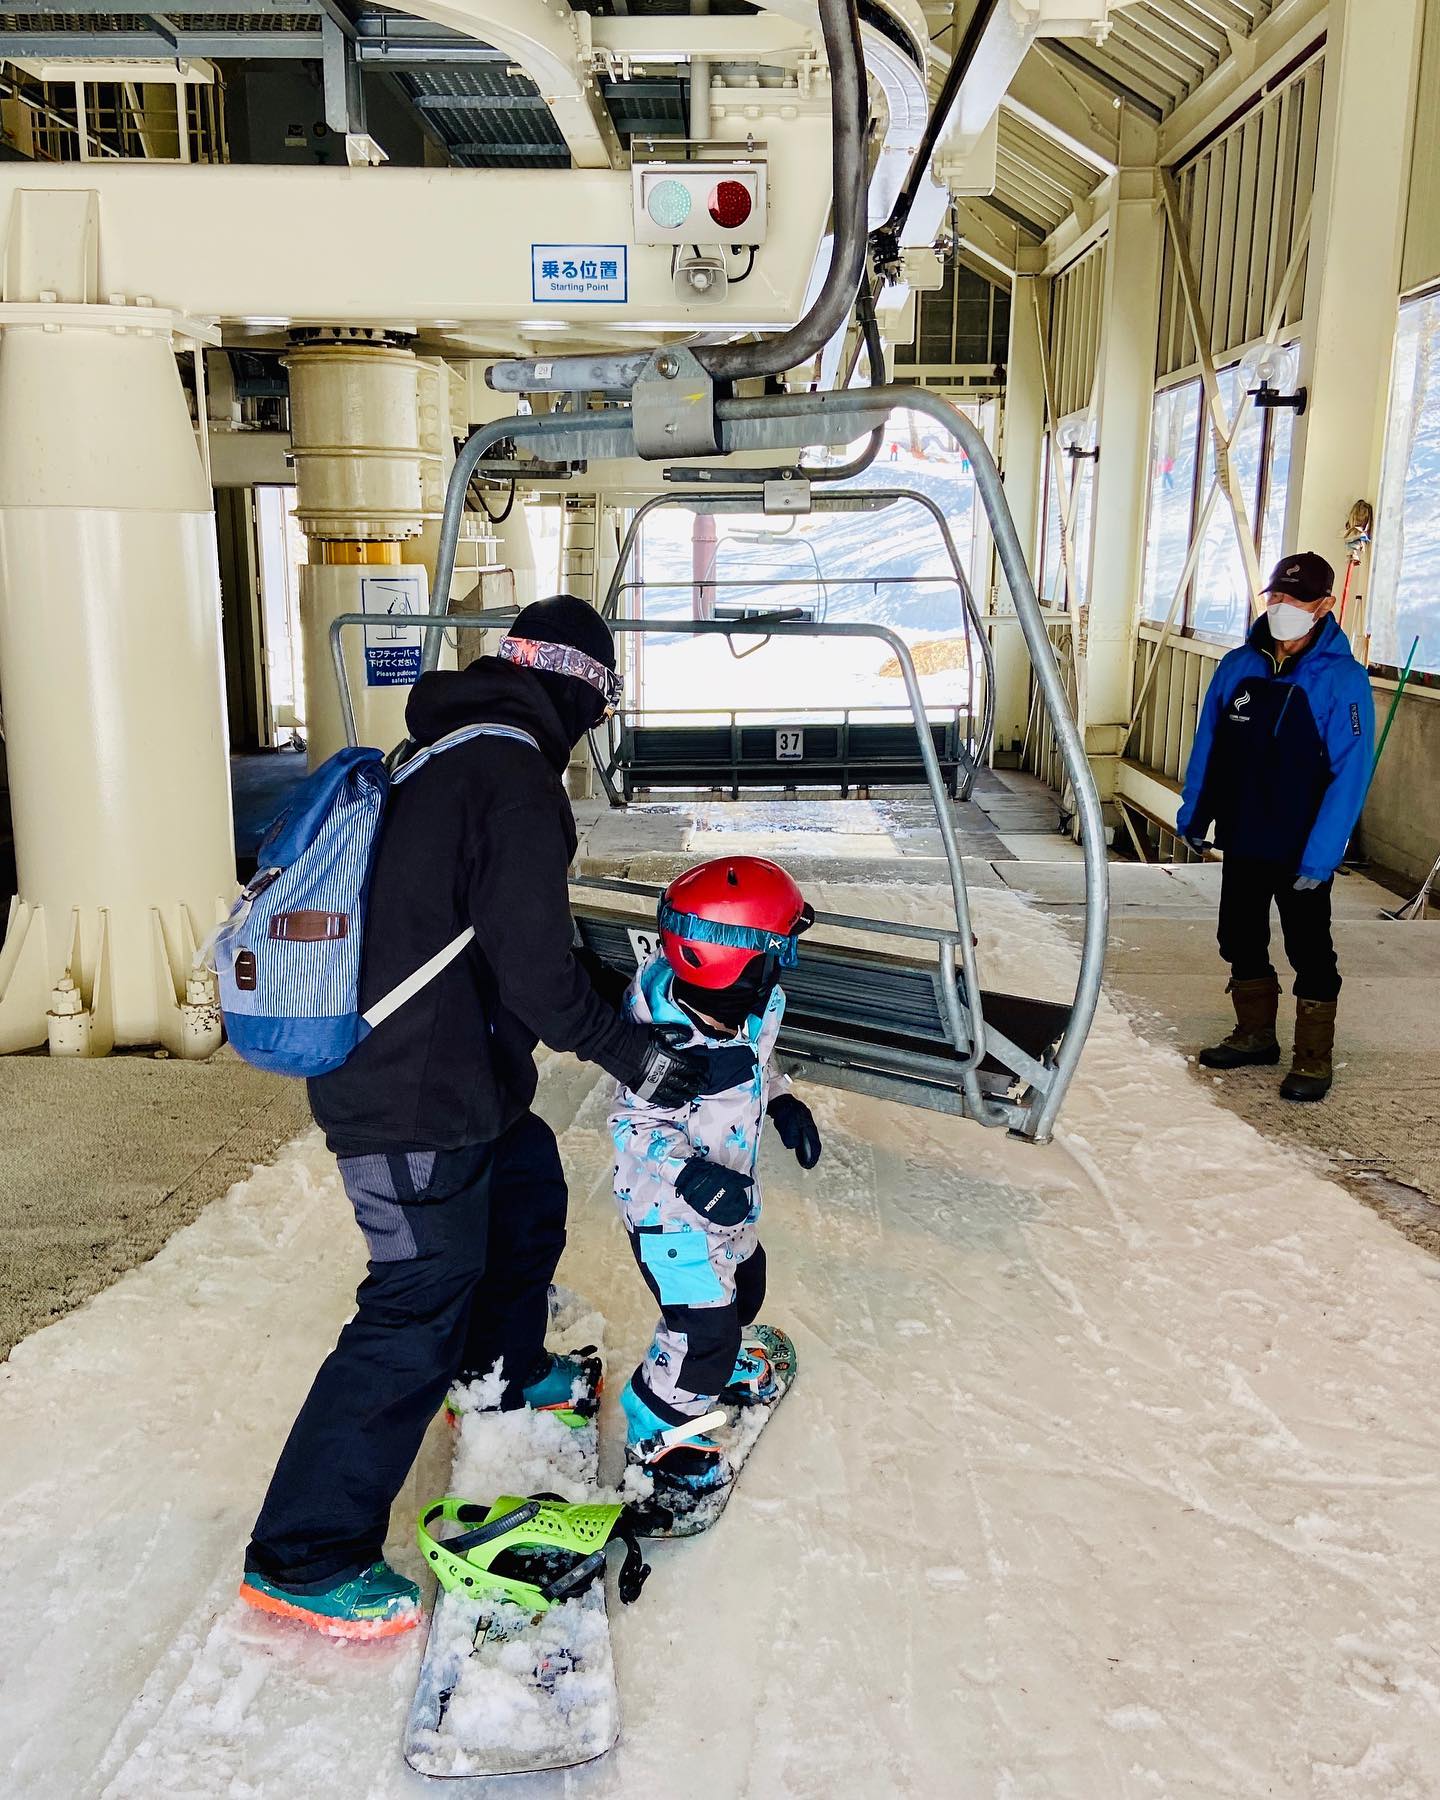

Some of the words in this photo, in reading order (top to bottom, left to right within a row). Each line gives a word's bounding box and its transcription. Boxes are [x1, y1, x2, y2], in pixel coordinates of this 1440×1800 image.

[541, 260, 618, 280] 乗る位置
[550, 282, 584, 293] Starting
[586, 283, 609, 292] Point
[780, 733, 800, 750] 37
[703, 1187, 726, 1212] BURTON
